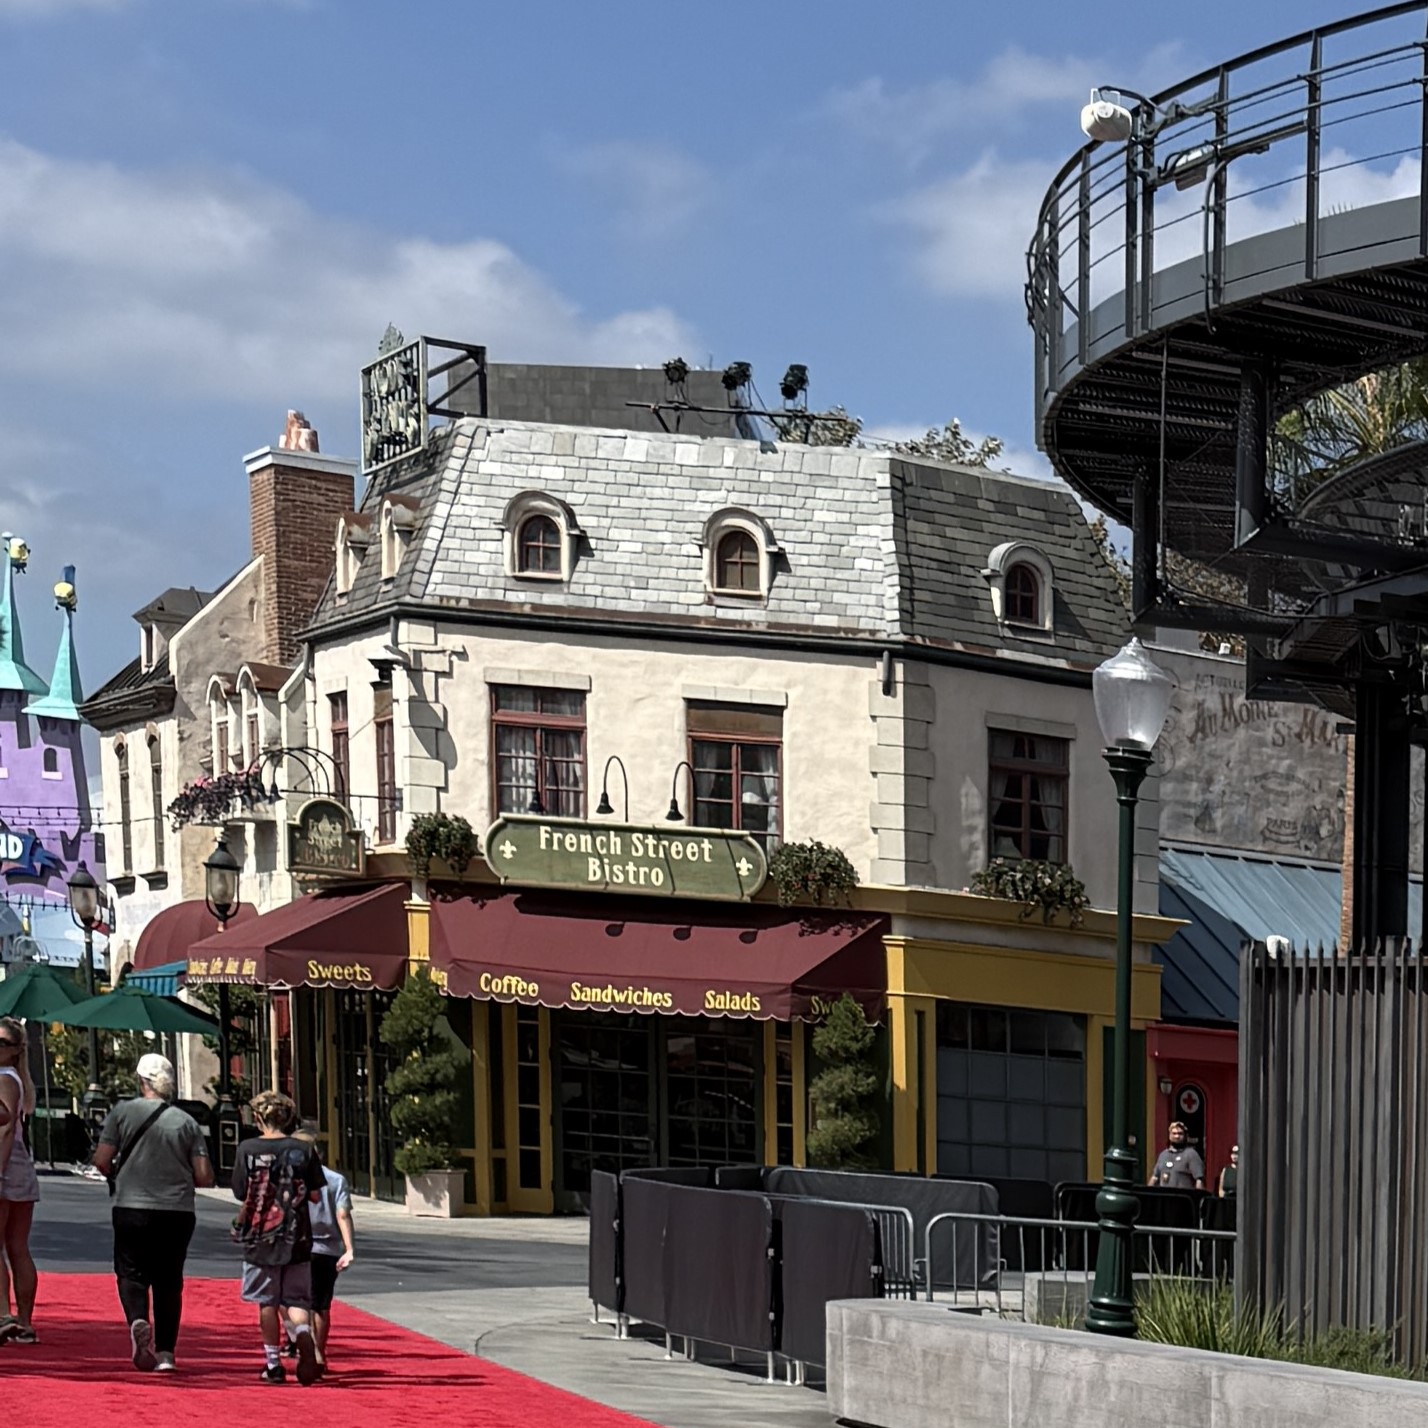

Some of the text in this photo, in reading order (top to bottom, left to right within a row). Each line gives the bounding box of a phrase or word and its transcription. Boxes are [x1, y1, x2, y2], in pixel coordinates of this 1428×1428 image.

[538, 825, 713, 863] French Street
[587, 856, 665, 887] Bistro
[307, 959, 373, 983] Sweets
[479, 973, 762, 1013] Coffee Sandwiches Salads
